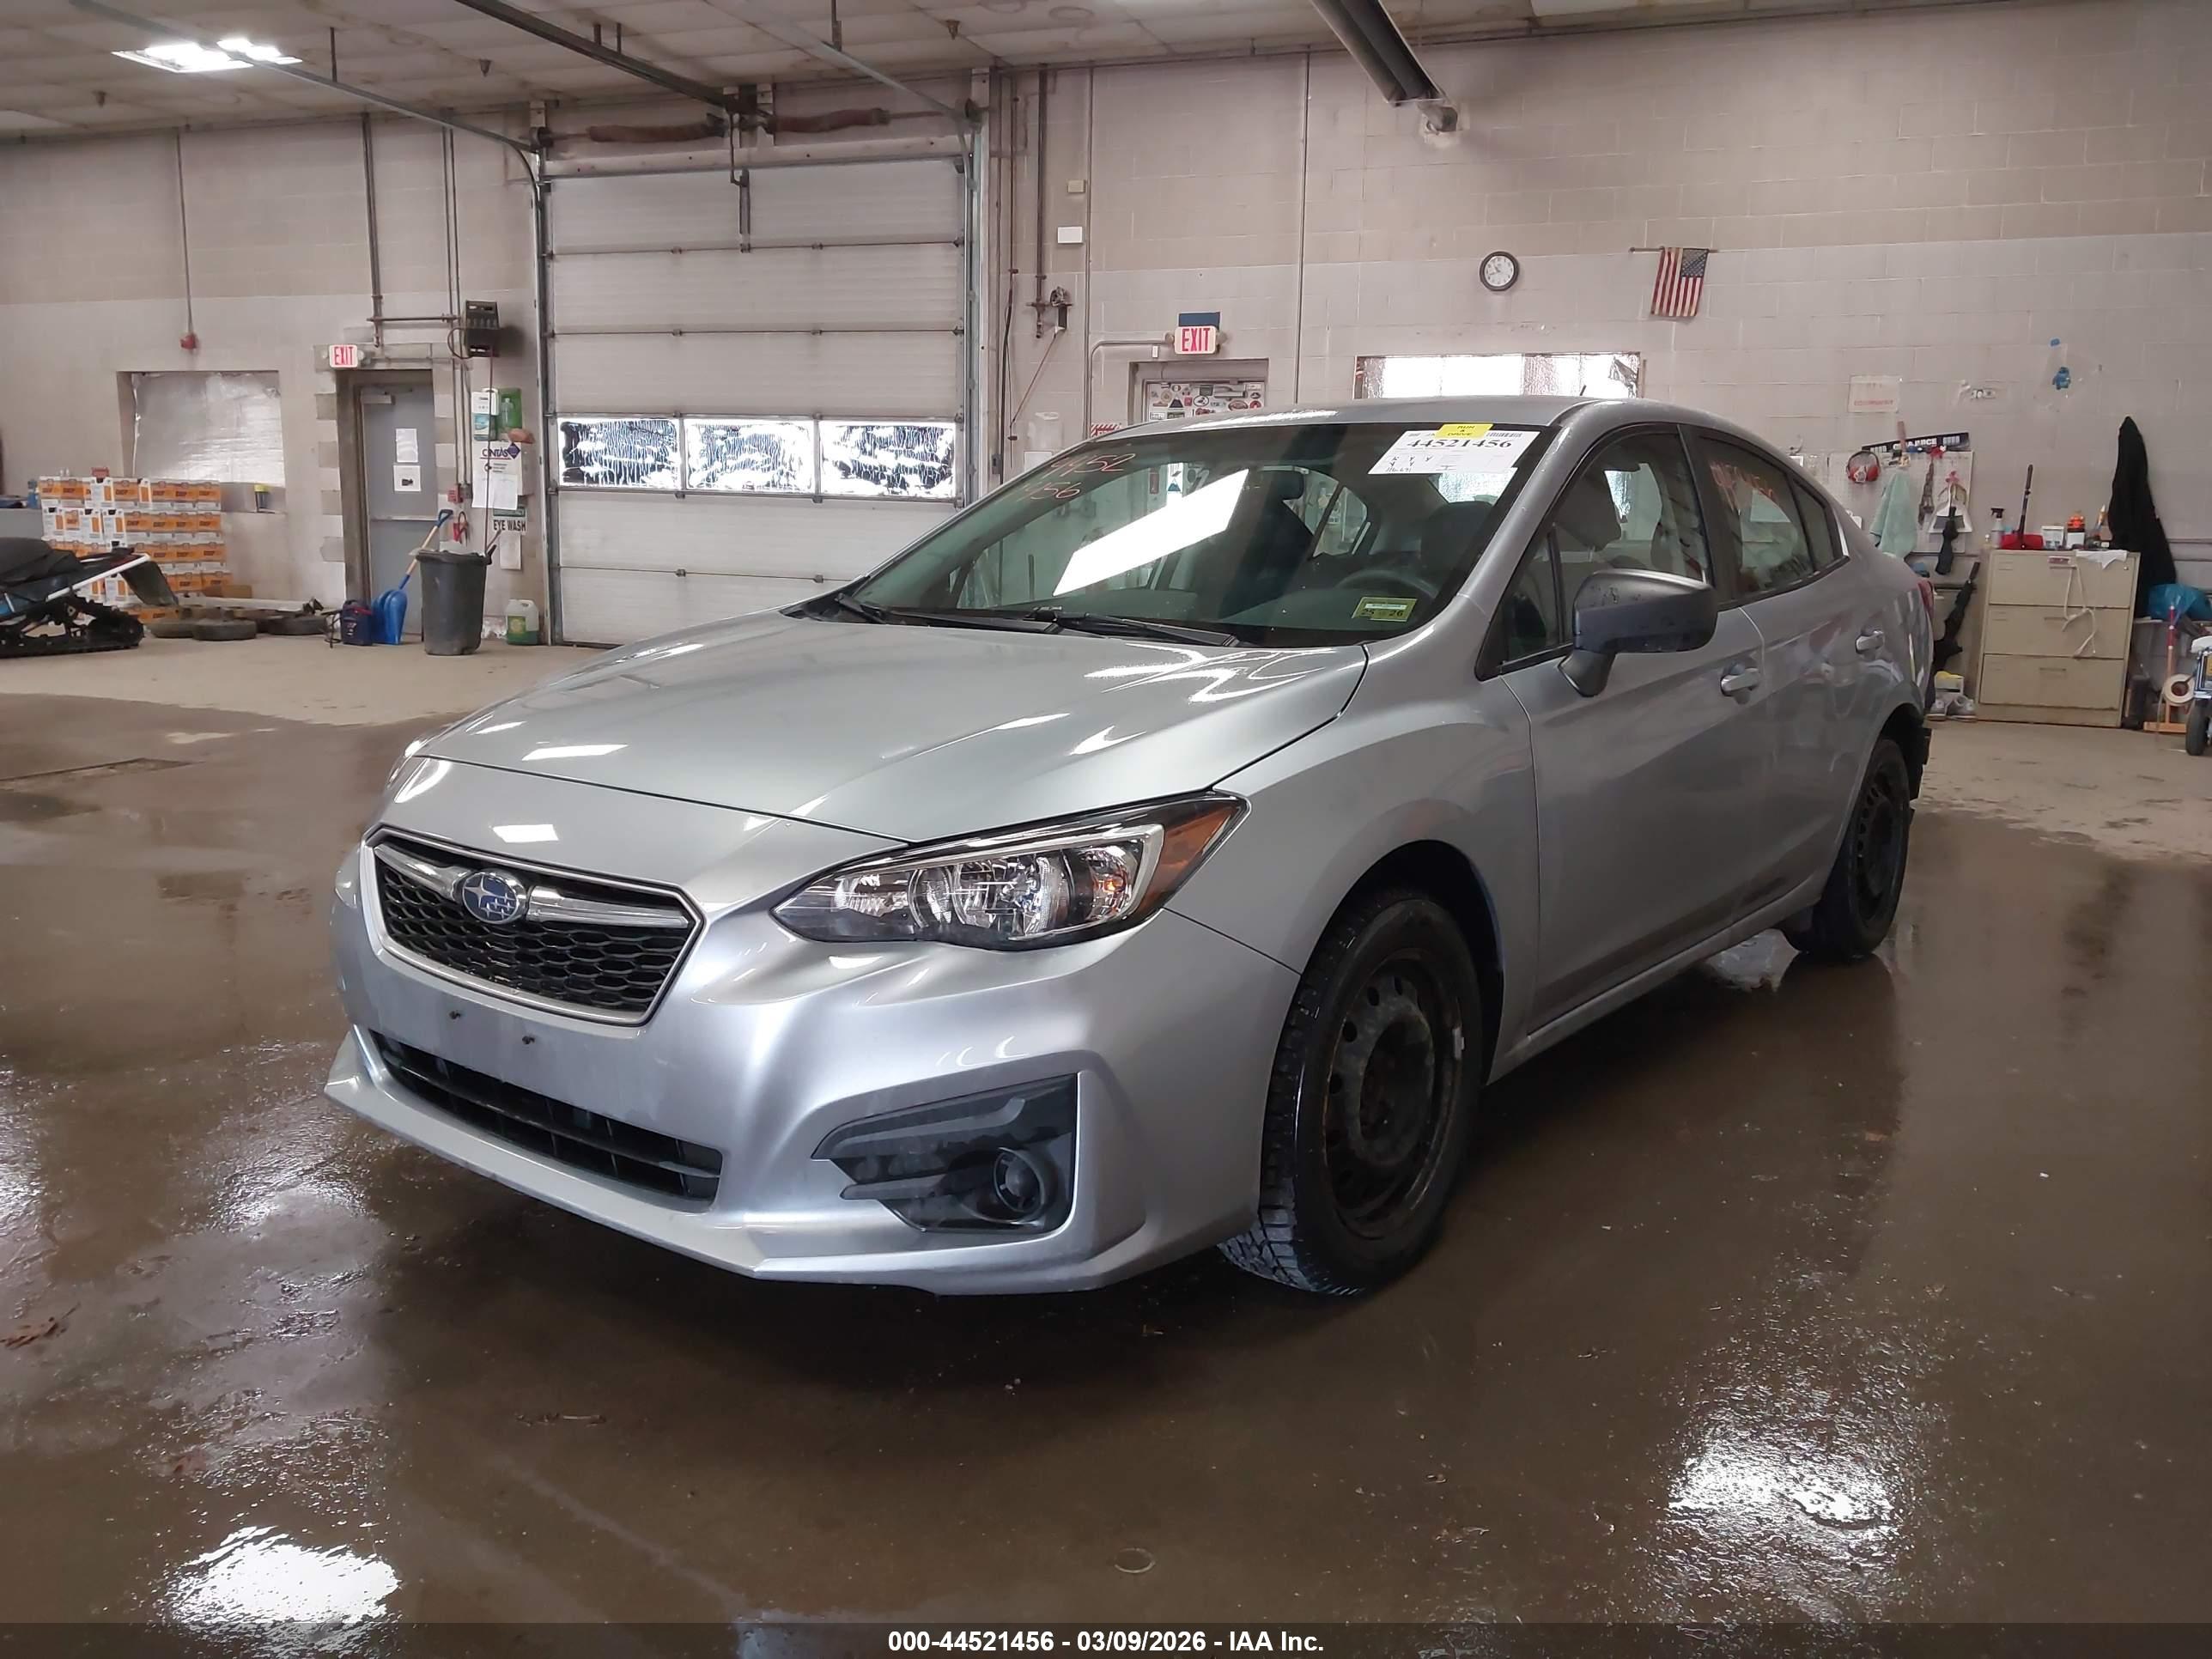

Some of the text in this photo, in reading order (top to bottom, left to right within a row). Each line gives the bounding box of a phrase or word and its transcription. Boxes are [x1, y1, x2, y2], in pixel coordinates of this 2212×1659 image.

[1182, 327, 1210, 351] EXIT
[334, 345, 354, 365] EXIT
[1407, 439, 1512, 447] 44521456
[482, 447, 508, 458] CNTAS
[493, 520, 526, 532] EYE WASH
